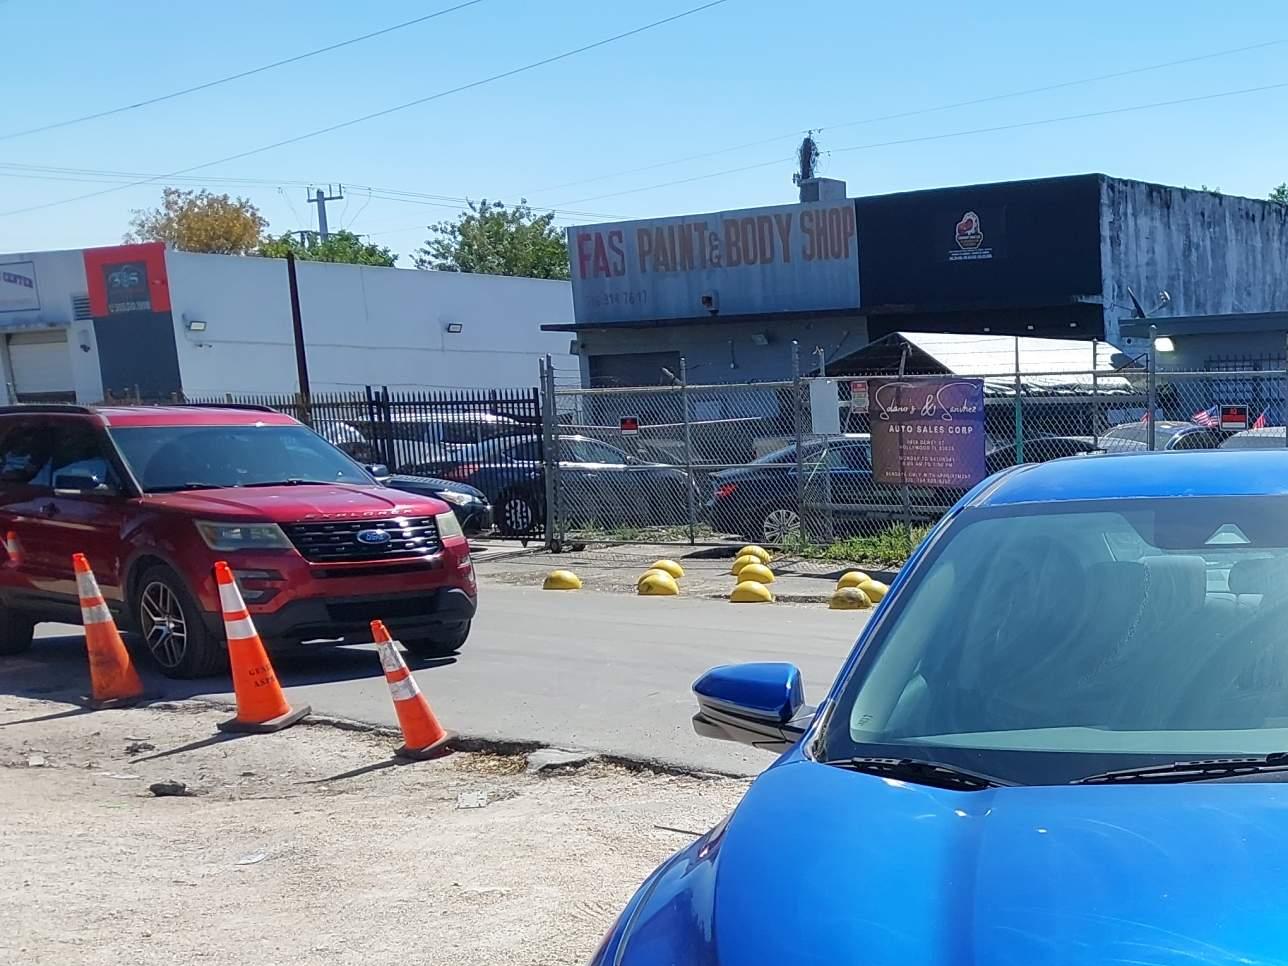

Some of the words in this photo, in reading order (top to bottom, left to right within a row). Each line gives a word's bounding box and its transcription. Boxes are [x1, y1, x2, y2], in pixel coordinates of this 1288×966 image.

[576, 230, 627, 280] FAS
[636, 222, 709, 274] PAINT
[724, 213, 794, 269] BODY
[800, 206, 855, 262] SHOP
[920, 394, 937, 416] &
[936, 382, 978, 420] Sanchez
[888, 425, 913, 433] AUTO
[916, 425, 945, 434] SALES
[948, 426, 973, 434] CORP
